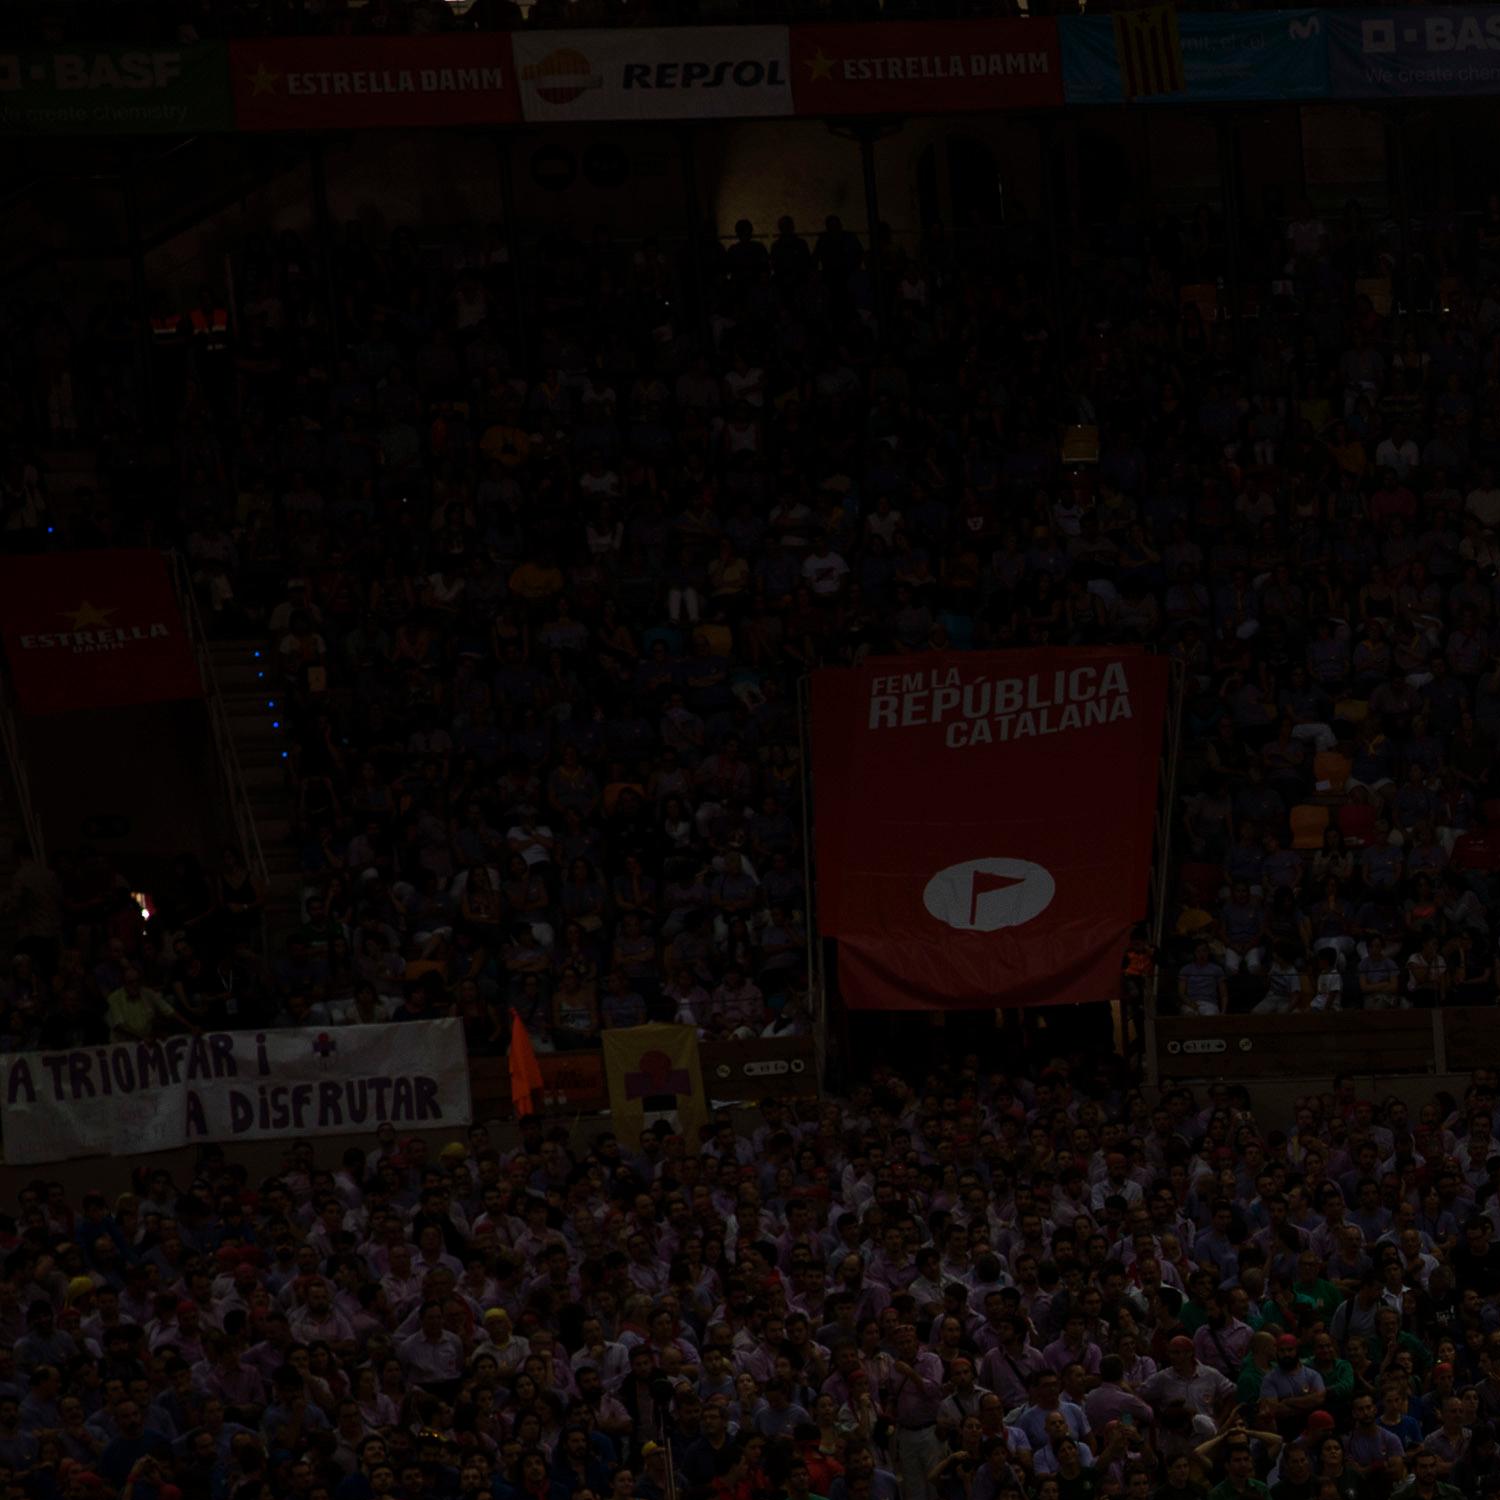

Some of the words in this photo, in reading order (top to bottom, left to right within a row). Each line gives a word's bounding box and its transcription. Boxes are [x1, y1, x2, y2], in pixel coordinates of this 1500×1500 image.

[53, 51, 182, 90] BASF
[622, 60, 786, 89] REPSOL
[843, 54, 966, 79] ESTRELLA
[970, 51, 1049, 76] DAMM
[1366, 67, 1393, 82] We
[1397, 66, 1453, 82] create
[286, 70, 416, 95] ESTRELLA
[421, 67, 505, 92] DAMM
[19, 622, 170, 649] ESTRELLA
[868, 661, 1130, 730] REPÚBLICA
[871, 672, 924, 696] FEM
[931, 667, 961, 688] LA
[945, 694, 1133, 748] CATALANA
[8, 1057, 37, 1103] A
[186, 1091, 208, 1137] A
